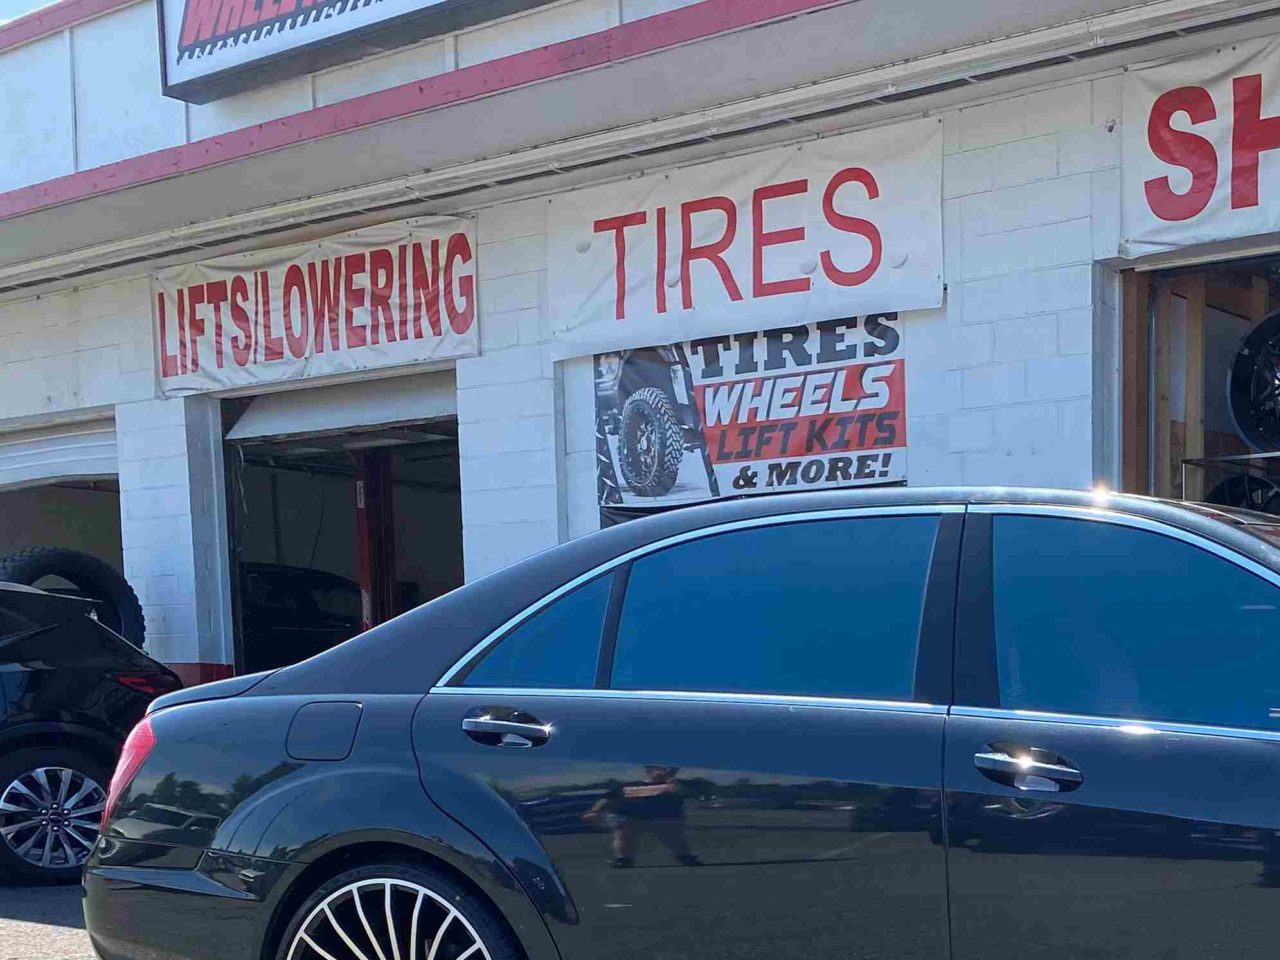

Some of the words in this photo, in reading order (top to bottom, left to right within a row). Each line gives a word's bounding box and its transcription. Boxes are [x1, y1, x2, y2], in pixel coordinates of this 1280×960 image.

[592, 166, 883, 320] TIRES
[157, 232, 475, 378] LIFTS/LOWERING
[690, 311, 901, 379] TIRES
[703, 362, 896, 429] WHEELS
[715, 419, 800, 462] LIFT
[804, 410, 901, 453] KITS
[731, 464, 758, 491] &
[765, 452, 894, 487] MORE!
